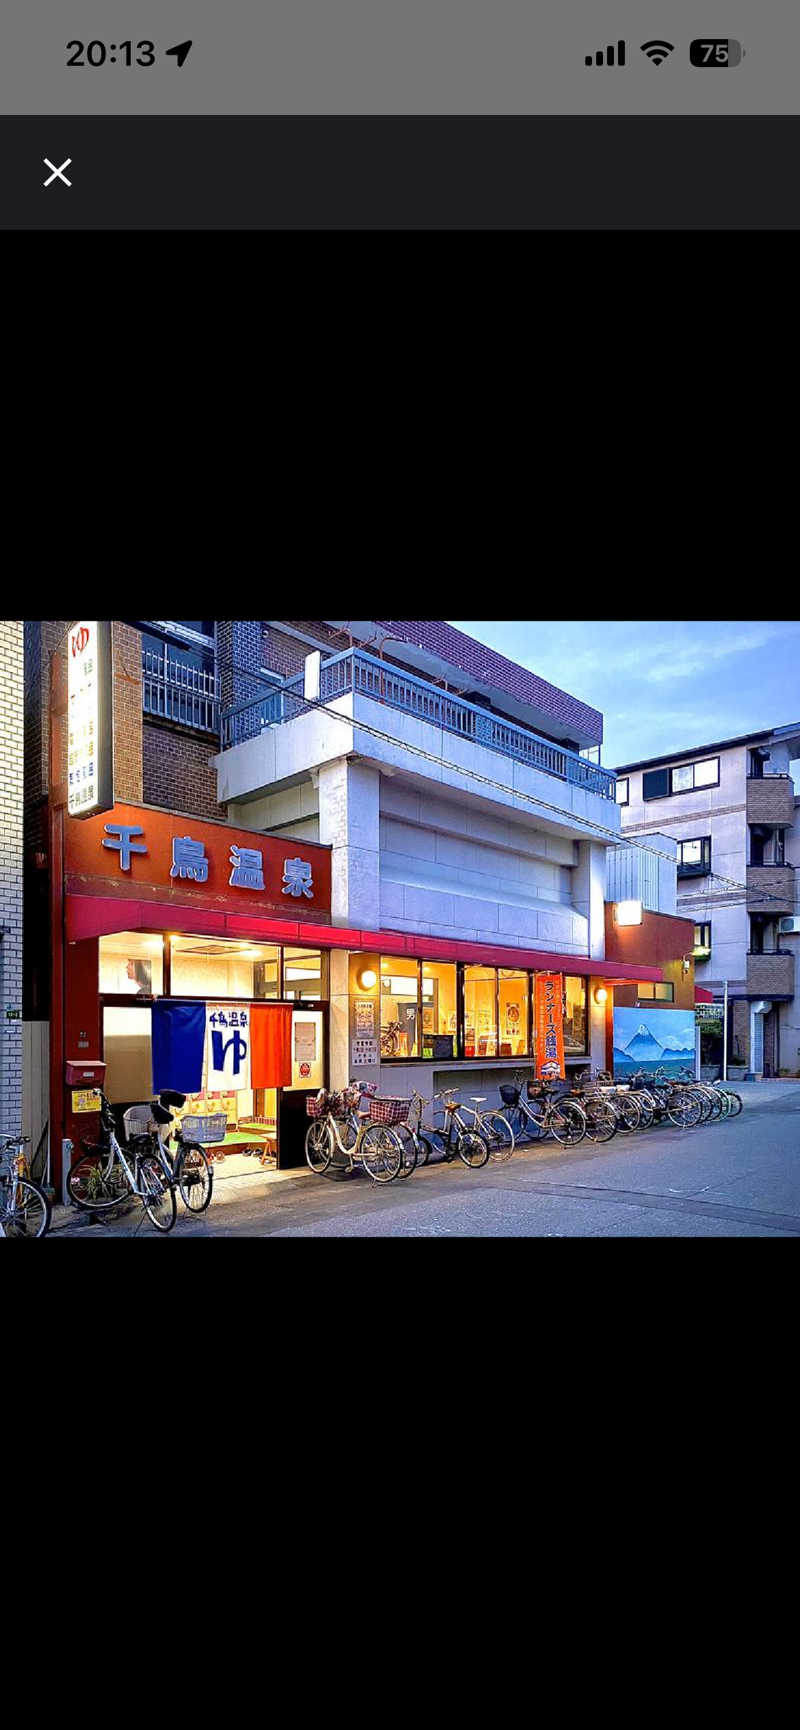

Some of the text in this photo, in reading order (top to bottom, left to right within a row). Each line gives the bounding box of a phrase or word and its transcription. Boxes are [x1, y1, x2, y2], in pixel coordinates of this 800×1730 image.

[72, 627, 89, 658] ゆ
[101, 823, 315, 900] 千鳥温泉
[209, 1011, 249, 1028] 千鳥温泉
[406, 1008, 415, 1020] 男
[211, 1030, 248, 1076] ゆ
